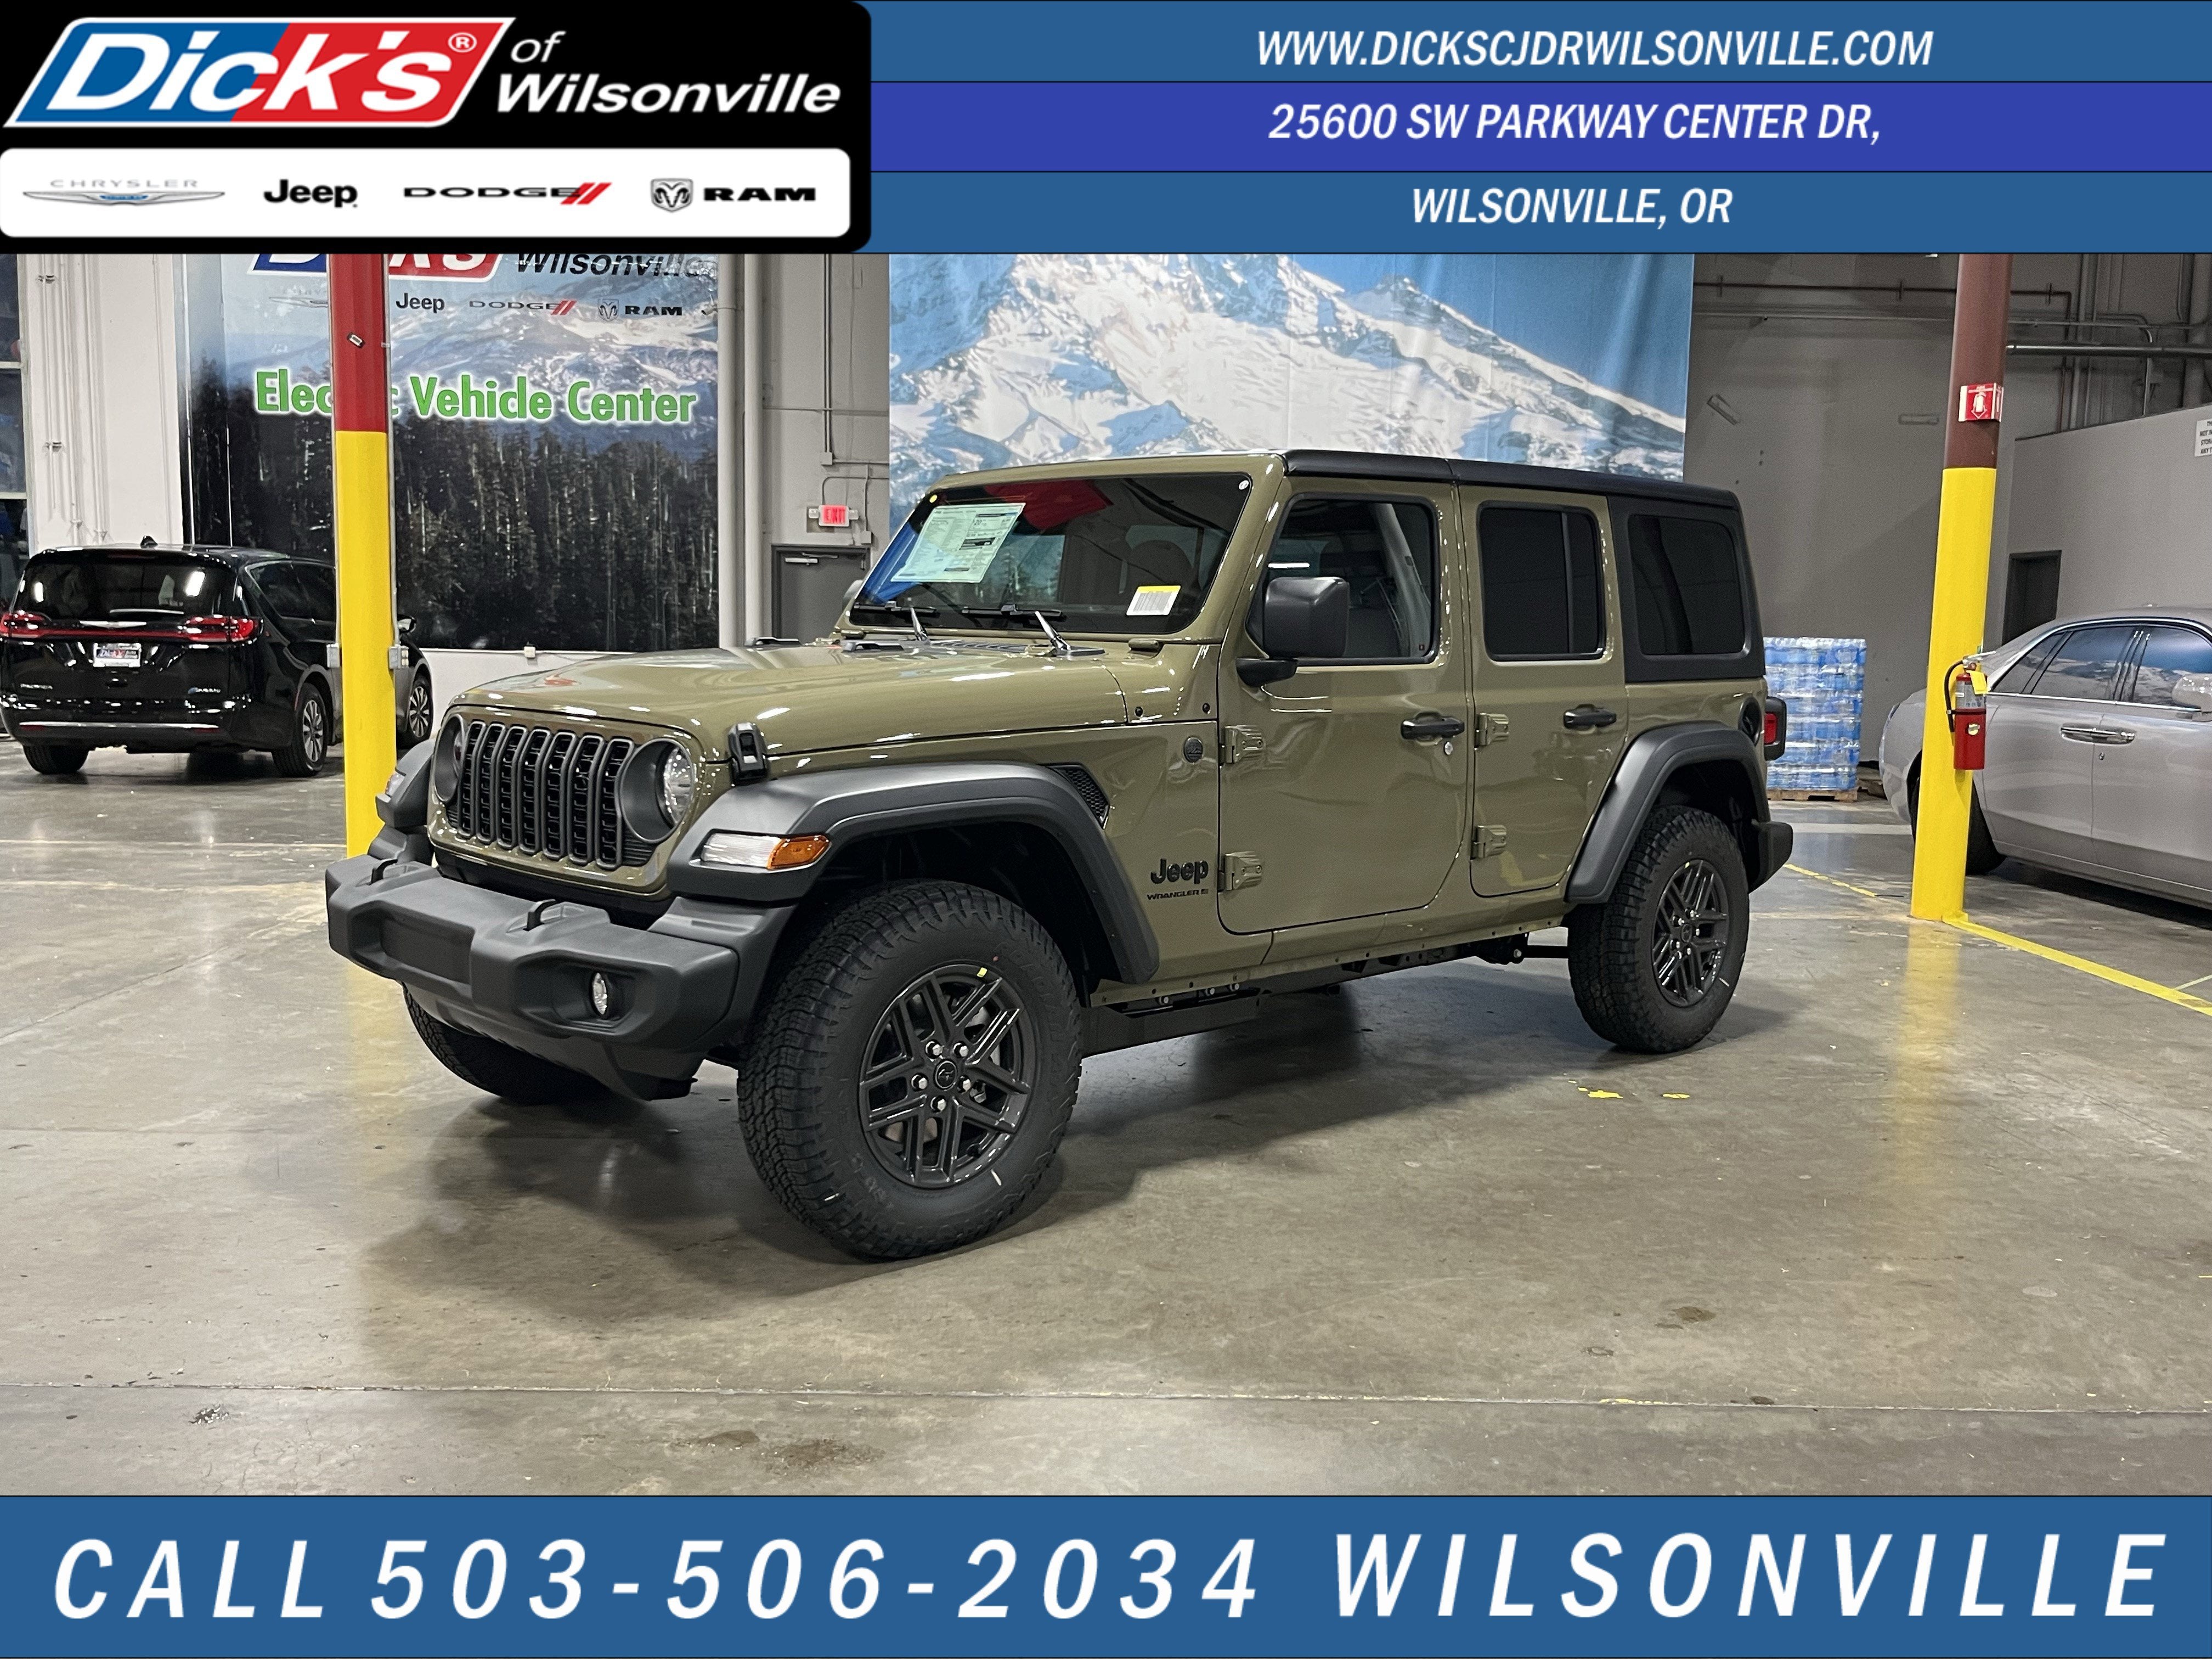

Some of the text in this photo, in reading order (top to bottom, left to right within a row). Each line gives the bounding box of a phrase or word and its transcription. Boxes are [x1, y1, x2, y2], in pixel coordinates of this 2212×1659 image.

[396, 293, 445, 313] Jeep
[470, 301, 562, 309] DODGE
[625, 305, 682, 316] RAM
[410, 375, 552, 419] Vehicle
[568, 381, 696, 421] Center
[826, 508, 845, 523] EXIT
[1150, 858, 1209, 884] Jeep
[1147, 889, 1199, 901] WRANGLER
